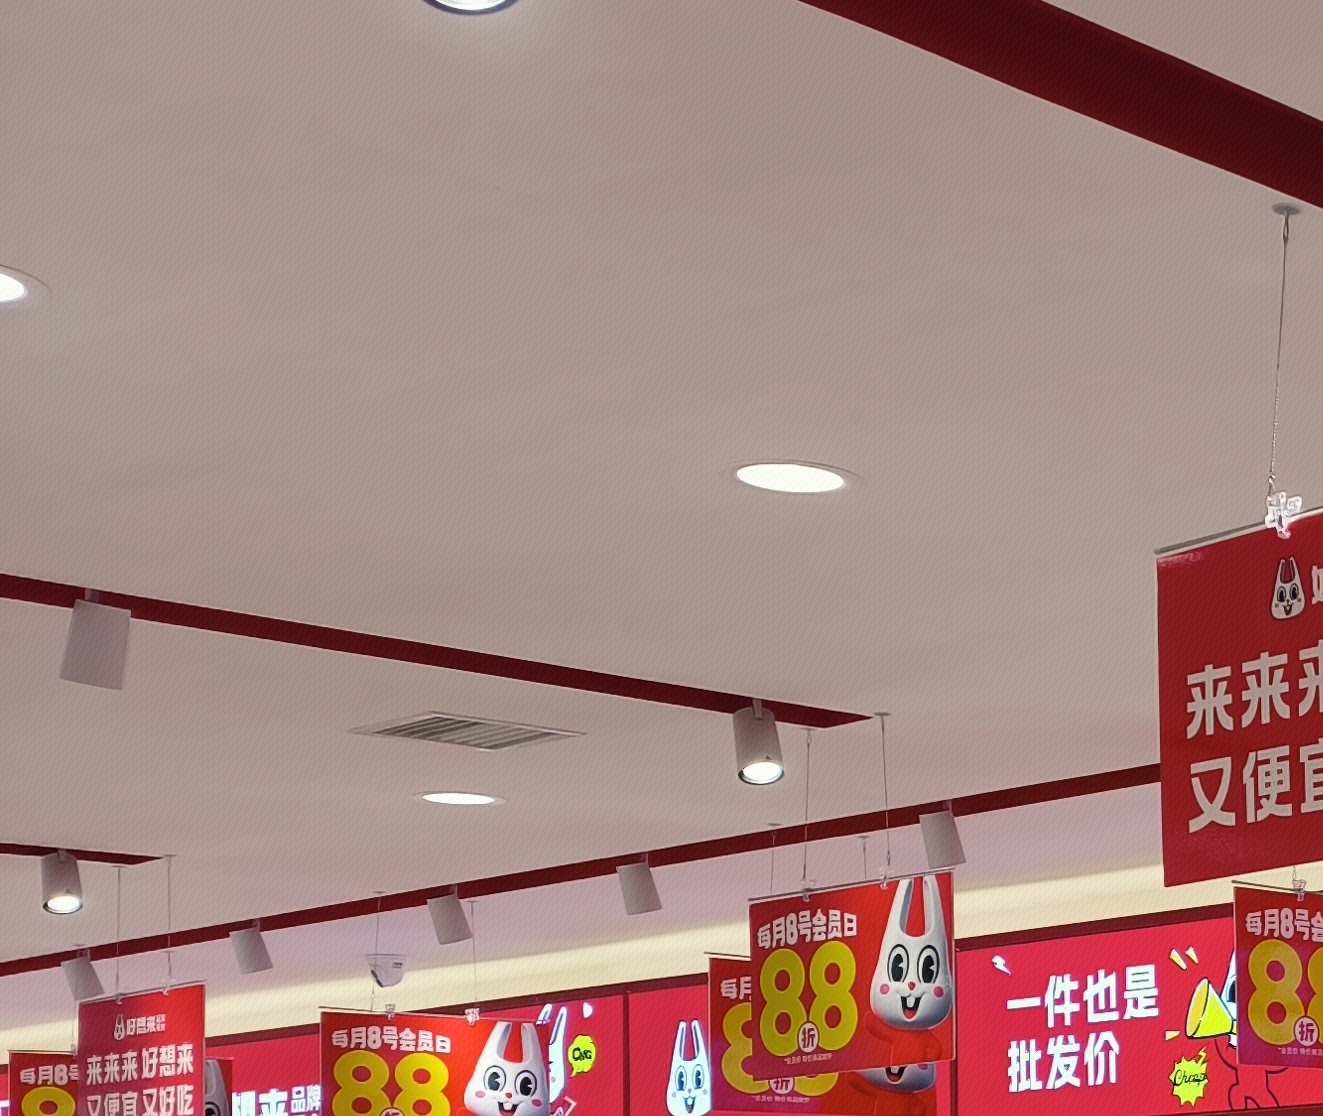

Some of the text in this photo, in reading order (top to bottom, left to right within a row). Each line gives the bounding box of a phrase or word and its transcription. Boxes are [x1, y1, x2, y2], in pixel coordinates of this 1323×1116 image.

[757, 908, 858, 949] 每月8号会员日
[760, 940, 858, 1056] 88
[1006, 964, 1160, 1028] 一件也是
[87, 1042, 194, 1086] 来来来 好想来
[332, 1026, 451, 1053] 每月8号会员日
[1008, 1032, 1121, 1093] 批发价
